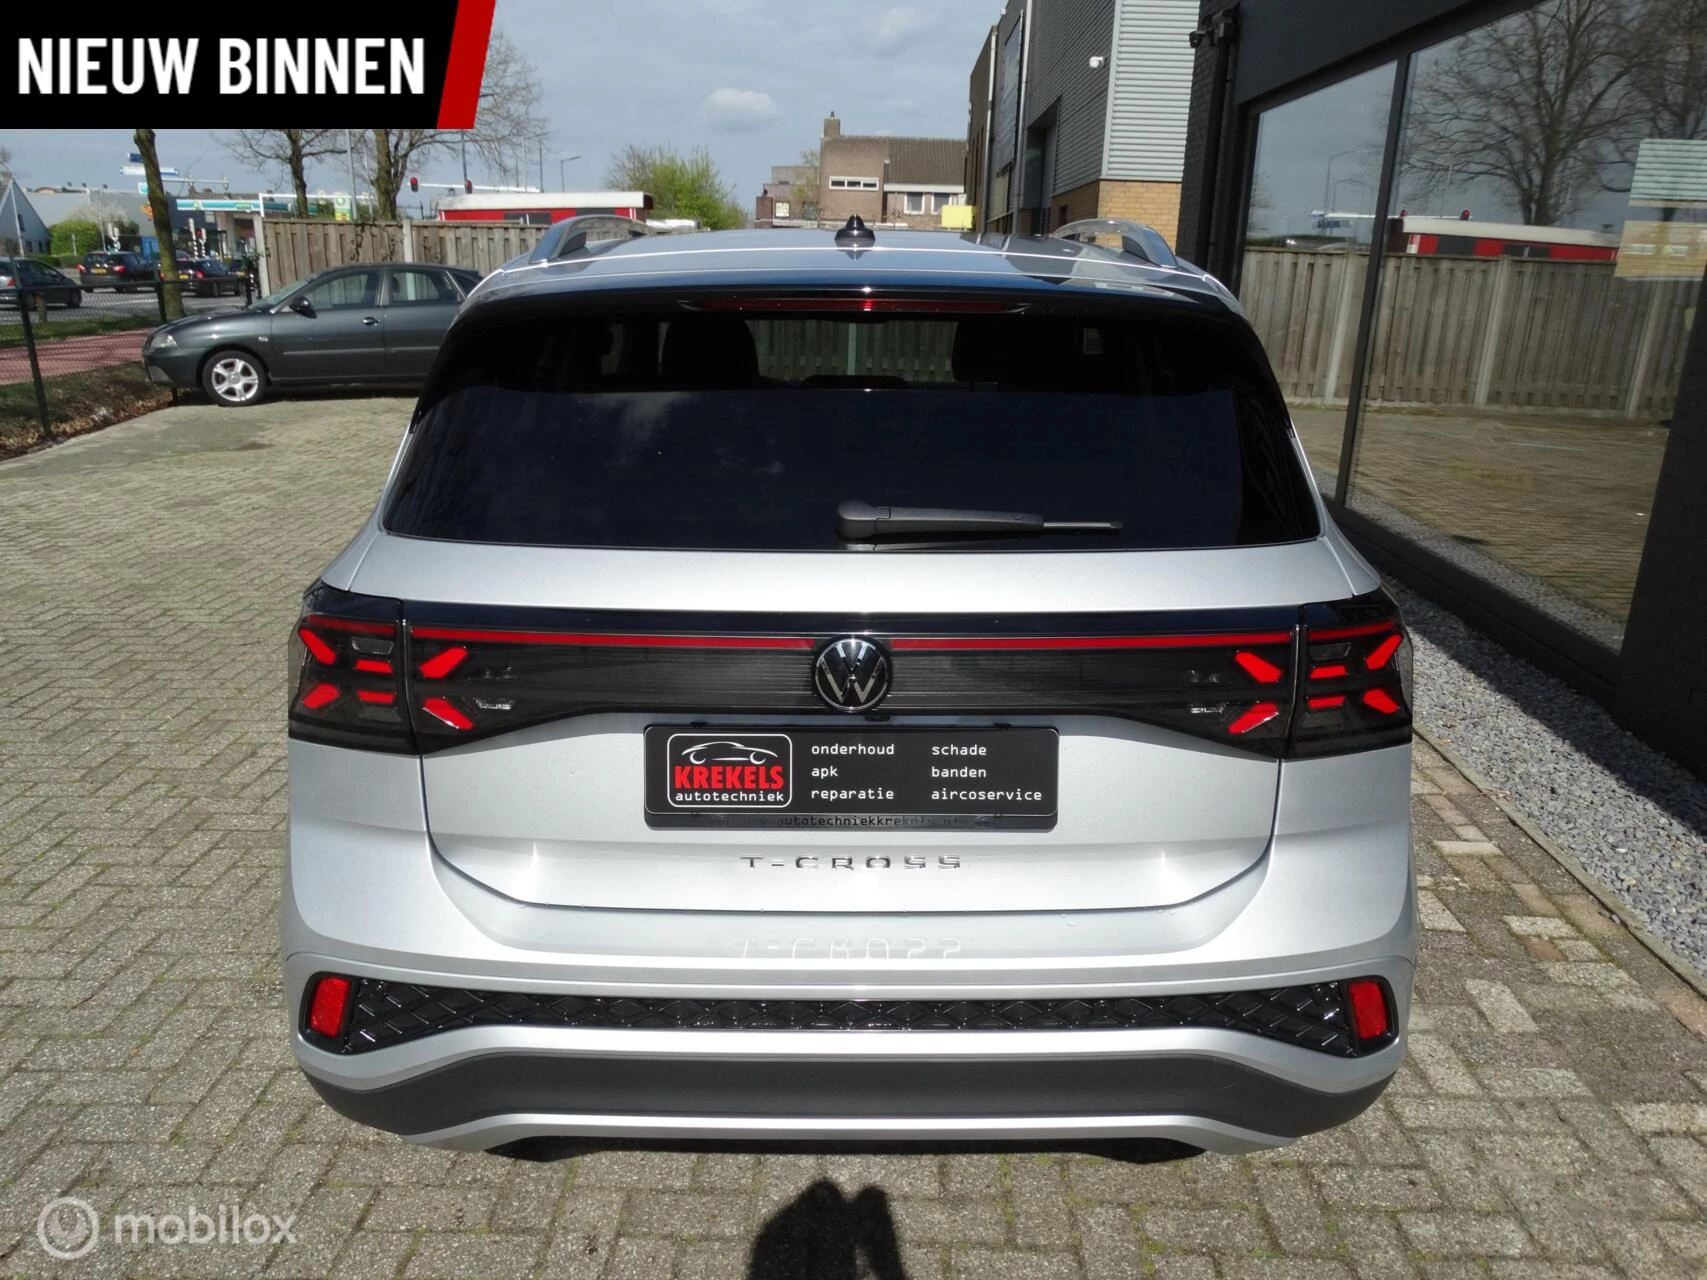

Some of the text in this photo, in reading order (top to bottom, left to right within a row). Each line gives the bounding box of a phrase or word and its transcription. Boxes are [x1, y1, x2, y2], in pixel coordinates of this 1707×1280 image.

[811, 743, 895, 756] onderhoud
[931, 744, 988, 756] schade
[674, 765, 785, 790] KREKELS
[811, 766, 839, 780] apk
[931, 766, 987, 778] banden
[675, 790, 785, 802] autotechniek
[811, 787, 895, 801] reparatie
[931, 788, 1043, 801] aircoservice
[740, 855, 962, 870] T-CROSS
